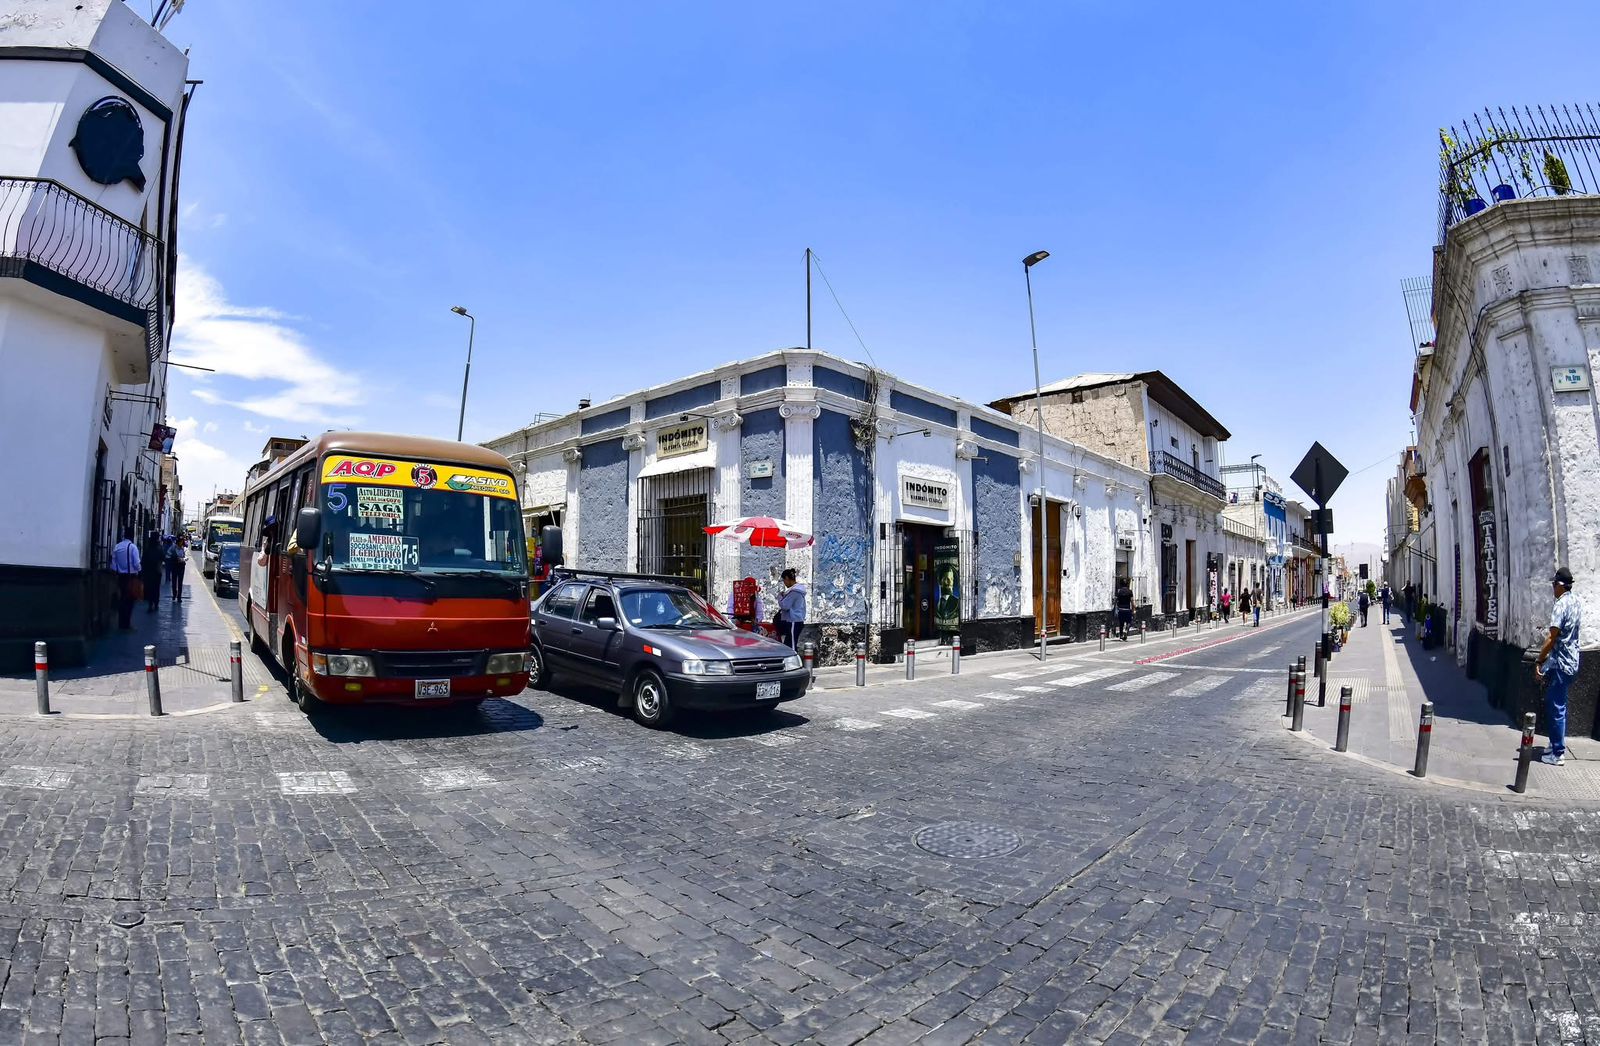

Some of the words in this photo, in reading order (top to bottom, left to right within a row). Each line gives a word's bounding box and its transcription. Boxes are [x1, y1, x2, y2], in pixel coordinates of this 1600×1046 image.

[658, 427, 704, 444] INDÓMITO
[325, 460, 397, 479] AQP
[418, 469, 431, 485] 5
[373, 488, 402, 498] LIBERTAD
[905, 481, 947, 496] INDÓMITO
[327, 483, 348, 511] 5
[359, 503, 402, 513] SAGA
[361, 511, 401, 519] TELEFONICA
[368, 535, 401, 545] AMERICAS
[402, 544, 418, 565] 7-5
[1482, 524, 1498, 624] TATUAJES
[417, 683, 448, 696] V3E-963
